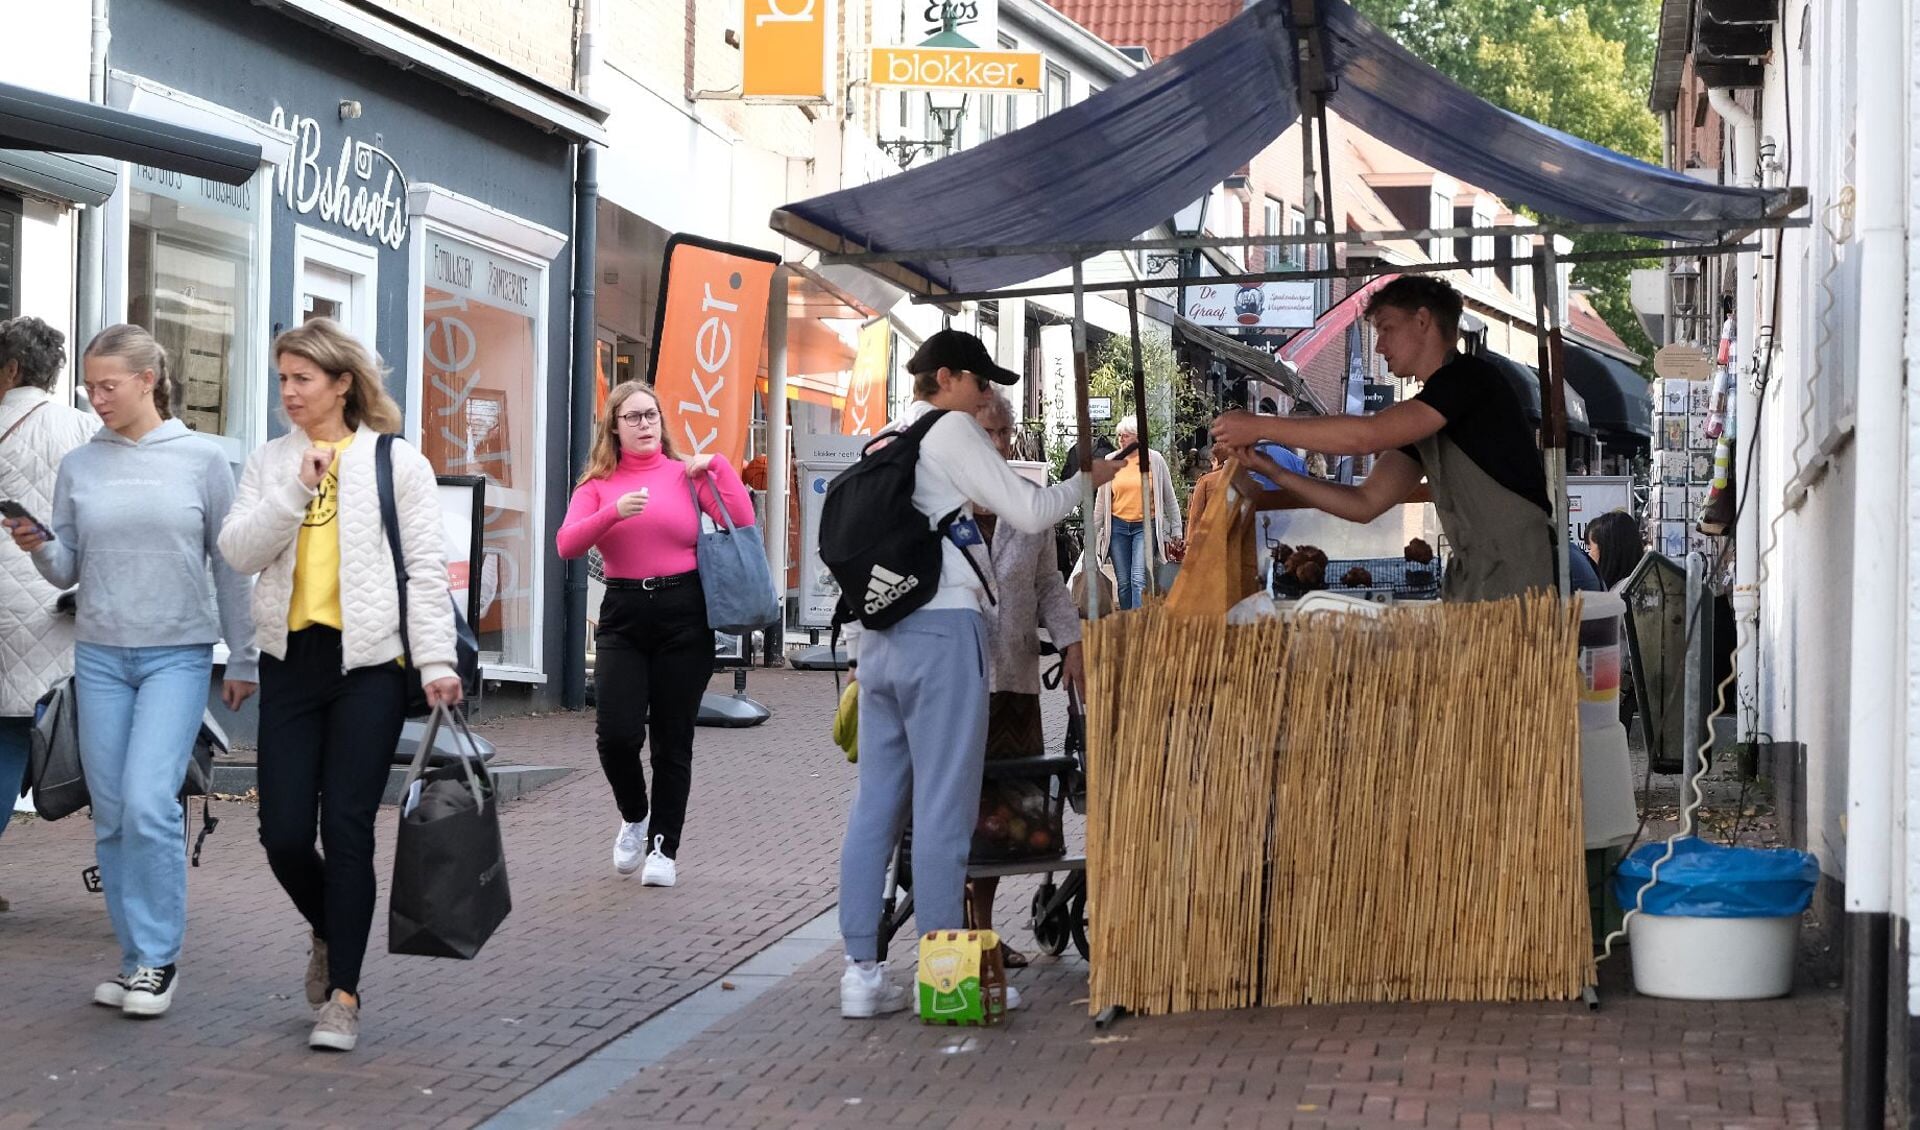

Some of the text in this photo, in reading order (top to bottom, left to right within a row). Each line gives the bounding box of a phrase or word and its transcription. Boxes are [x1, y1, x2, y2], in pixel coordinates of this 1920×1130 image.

[1200, 286, 1218, 299] De
[1188, 303, 1227, 320] Graaf
[864, 574, 919, 615] adidas
